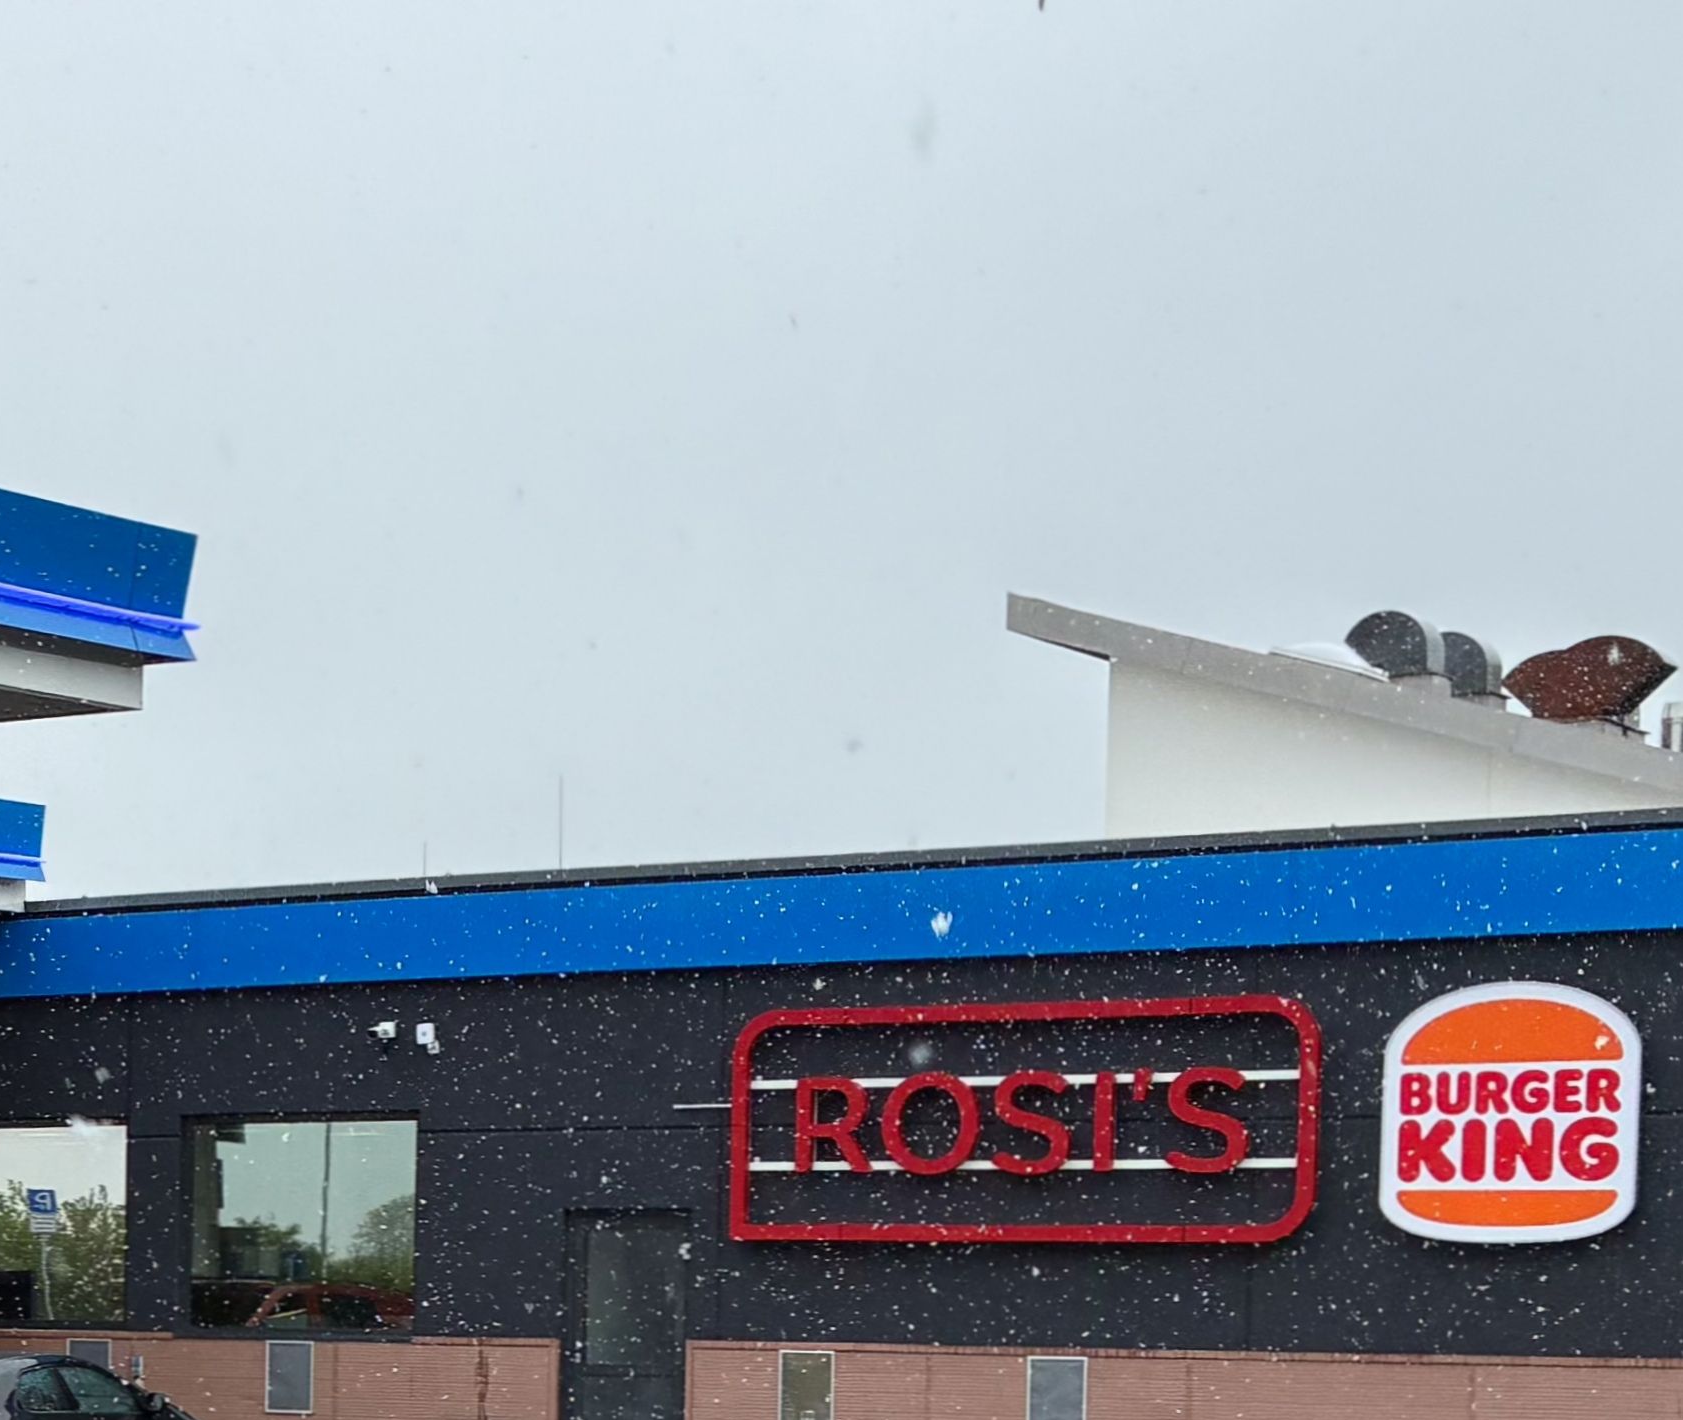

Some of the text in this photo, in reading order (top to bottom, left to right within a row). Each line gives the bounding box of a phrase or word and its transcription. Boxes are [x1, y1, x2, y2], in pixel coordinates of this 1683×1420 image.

[794, 1067, 1249, 1175] ROSI'S
[1399, 1068, 1622, 1115] BURGER
[1397, 1117, 1620, 1182] KING
